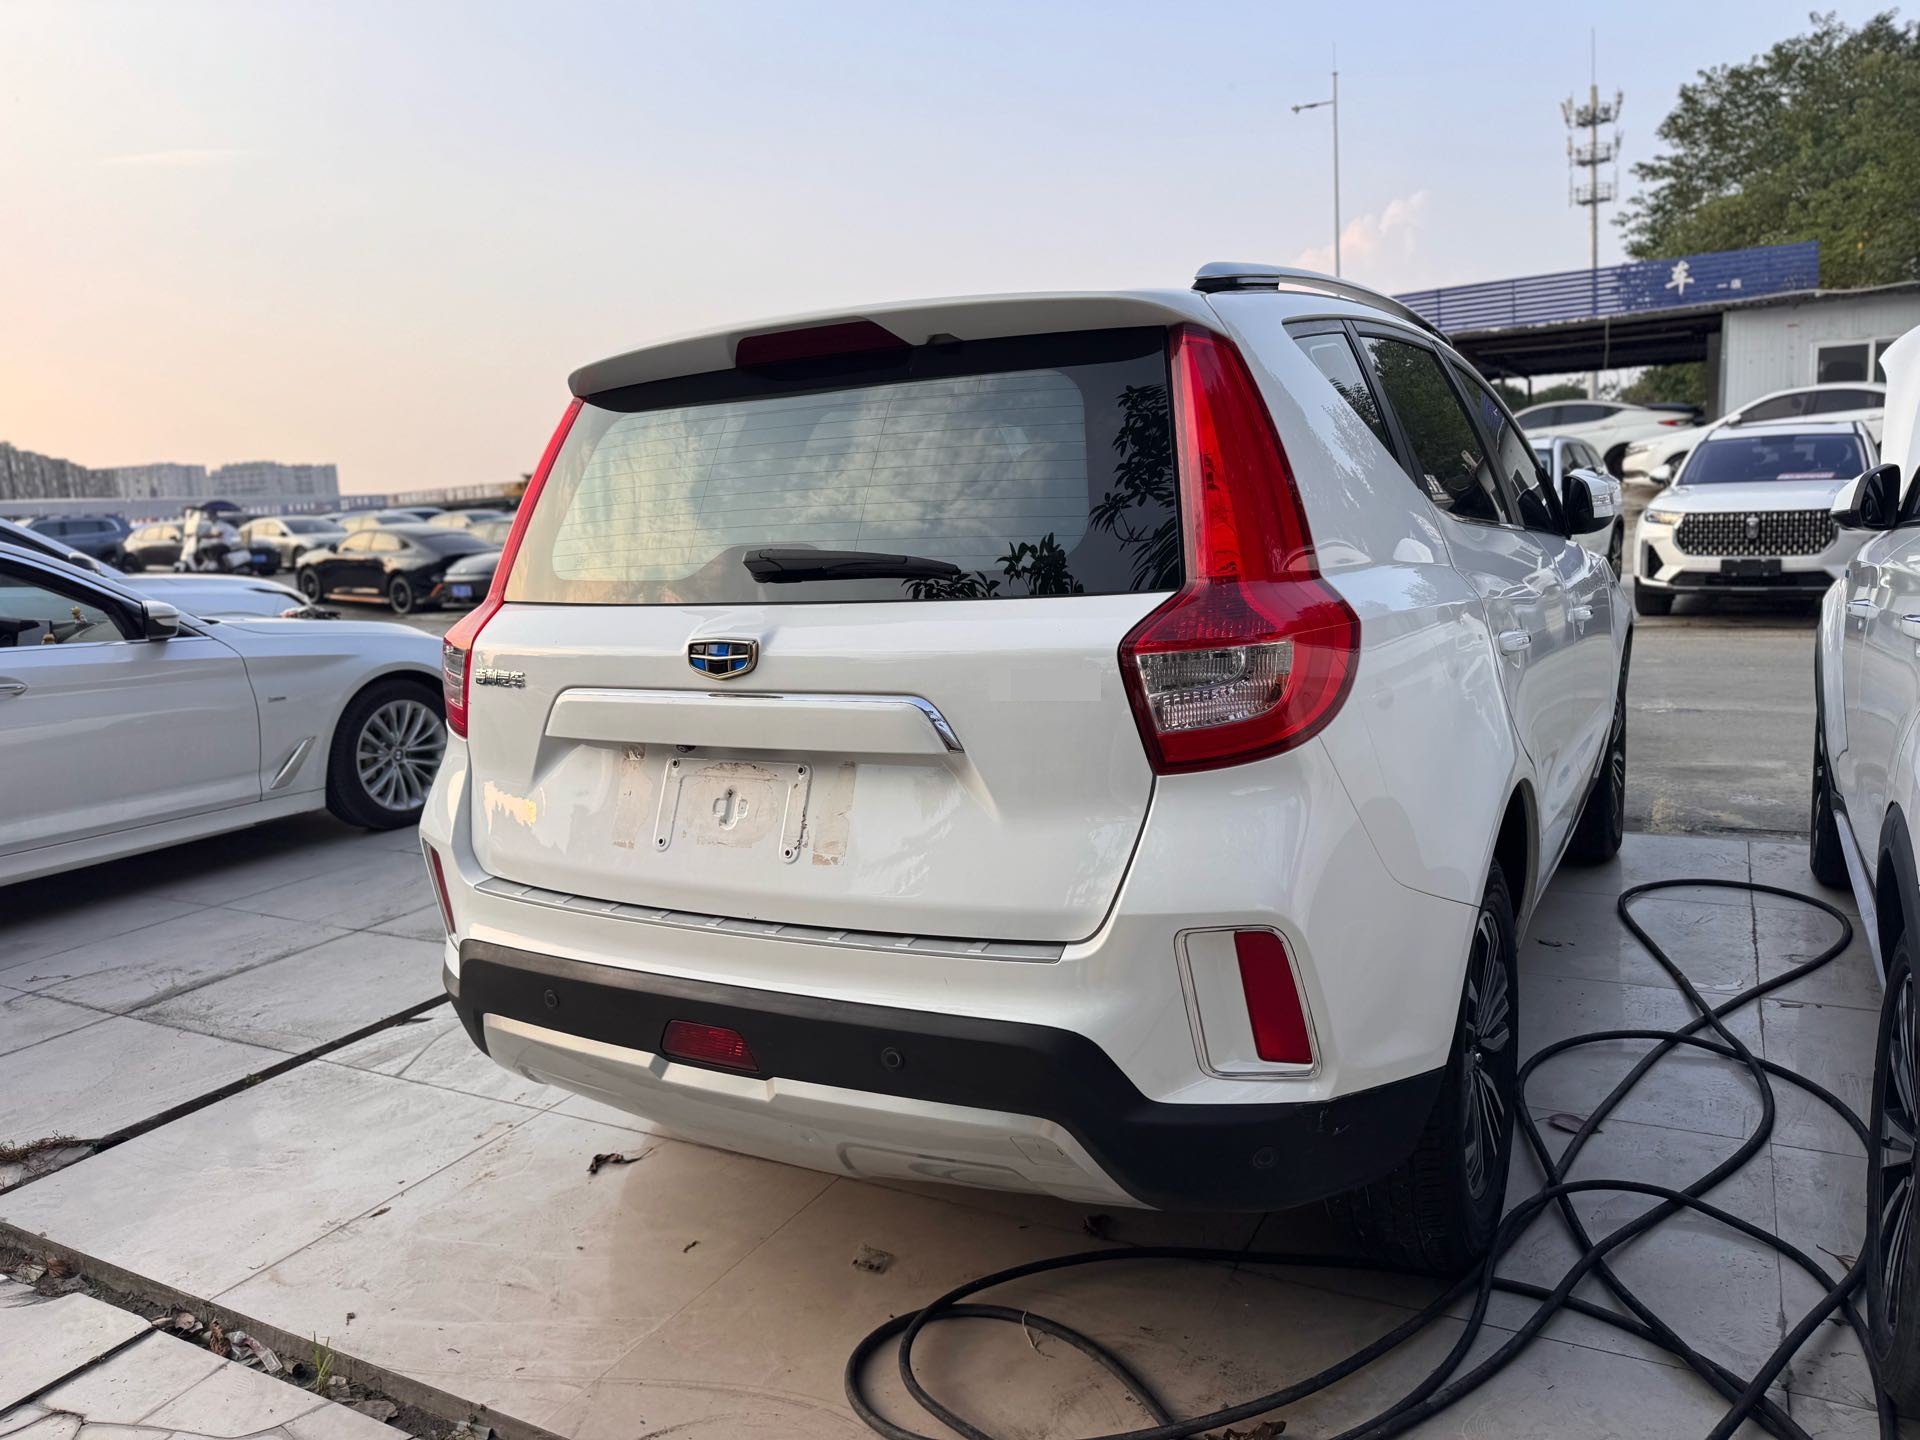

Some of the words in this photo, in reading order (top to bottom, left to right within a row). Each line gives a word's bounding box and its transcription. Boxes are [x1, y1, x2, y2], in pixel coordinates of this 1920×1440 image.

[1665, 260, 1694, 296] 车
[475, 668, 525, 688] 吉利汽车
